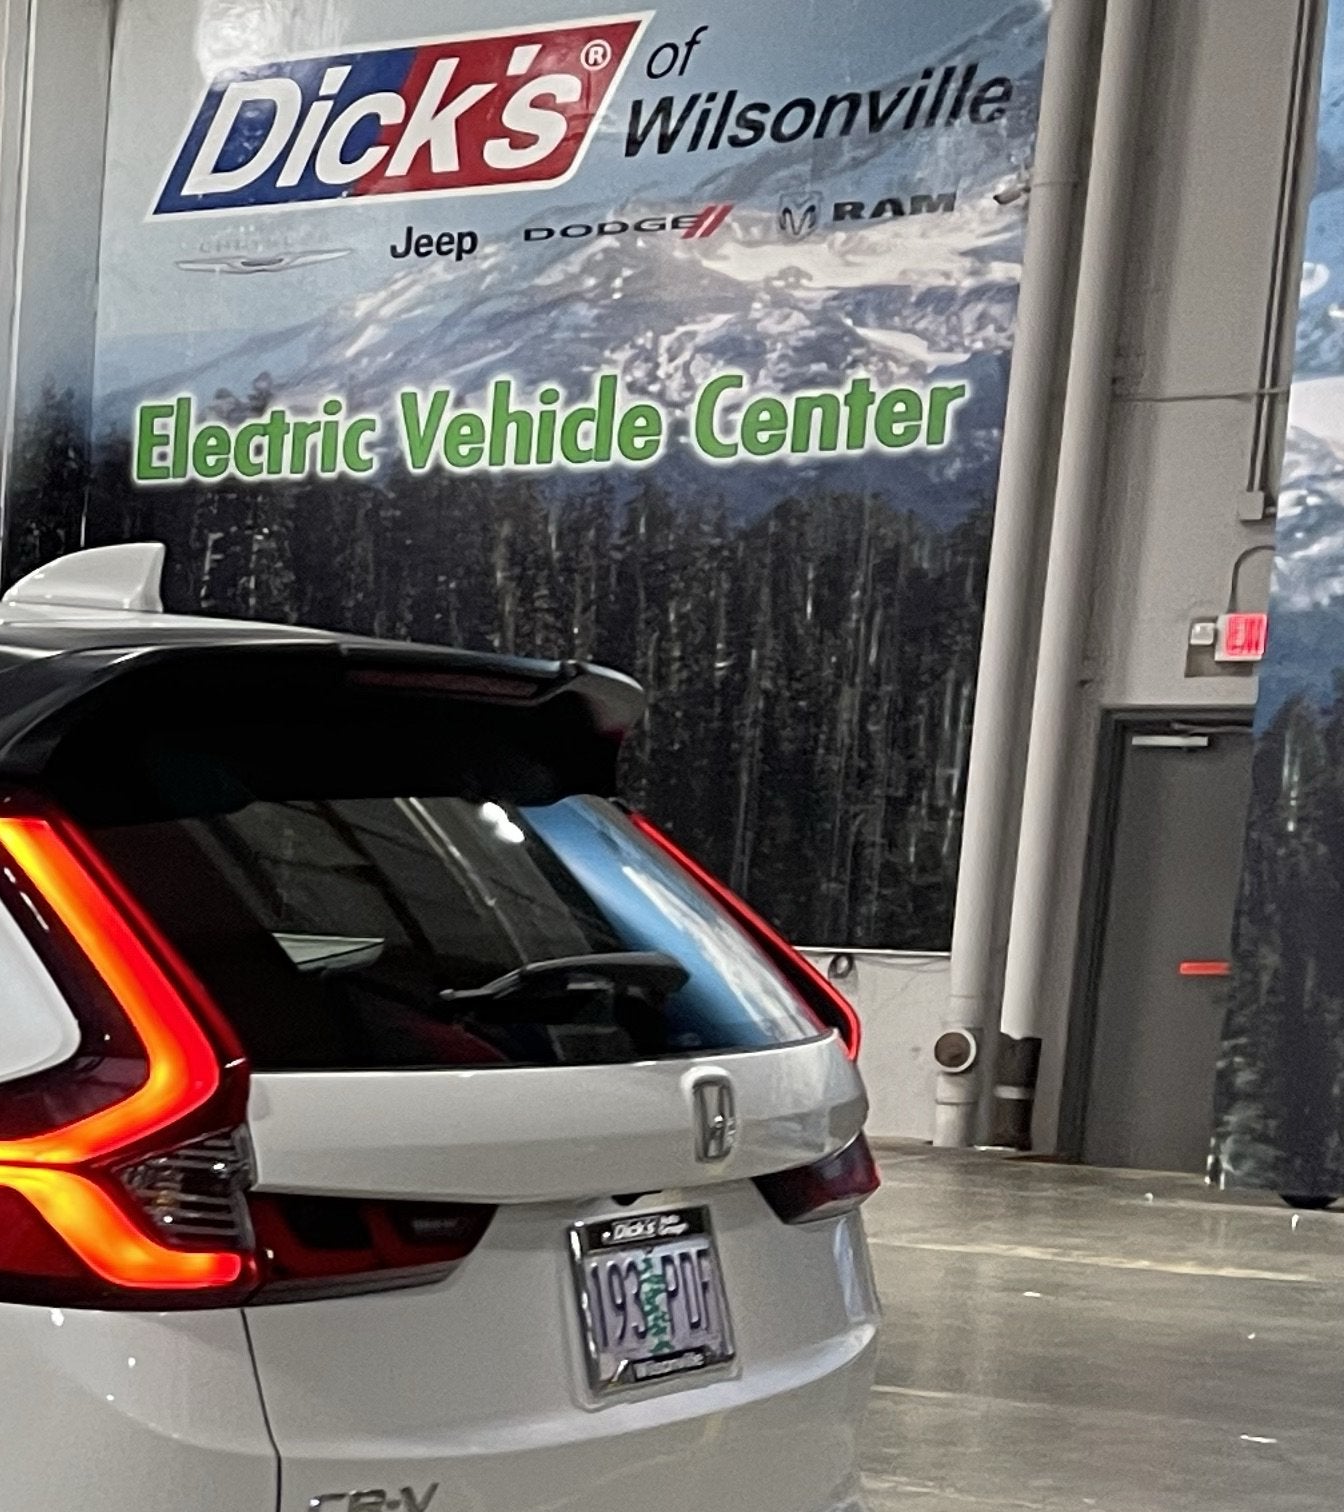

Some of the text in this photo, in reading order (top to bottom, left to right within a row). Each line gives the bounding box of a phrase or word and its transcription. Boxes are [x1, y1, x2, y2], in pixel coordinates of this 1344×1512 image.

[646, 25, 709, 80] of
[624, 62, 1014, 158] Wilsonville
[523, 214, 701, 242] DODGE
[832, 192, 957, 222] RAM
[390, 226, 479, 262] Jeep
[136, 375, 966, 480] Electric Vehicle Center
